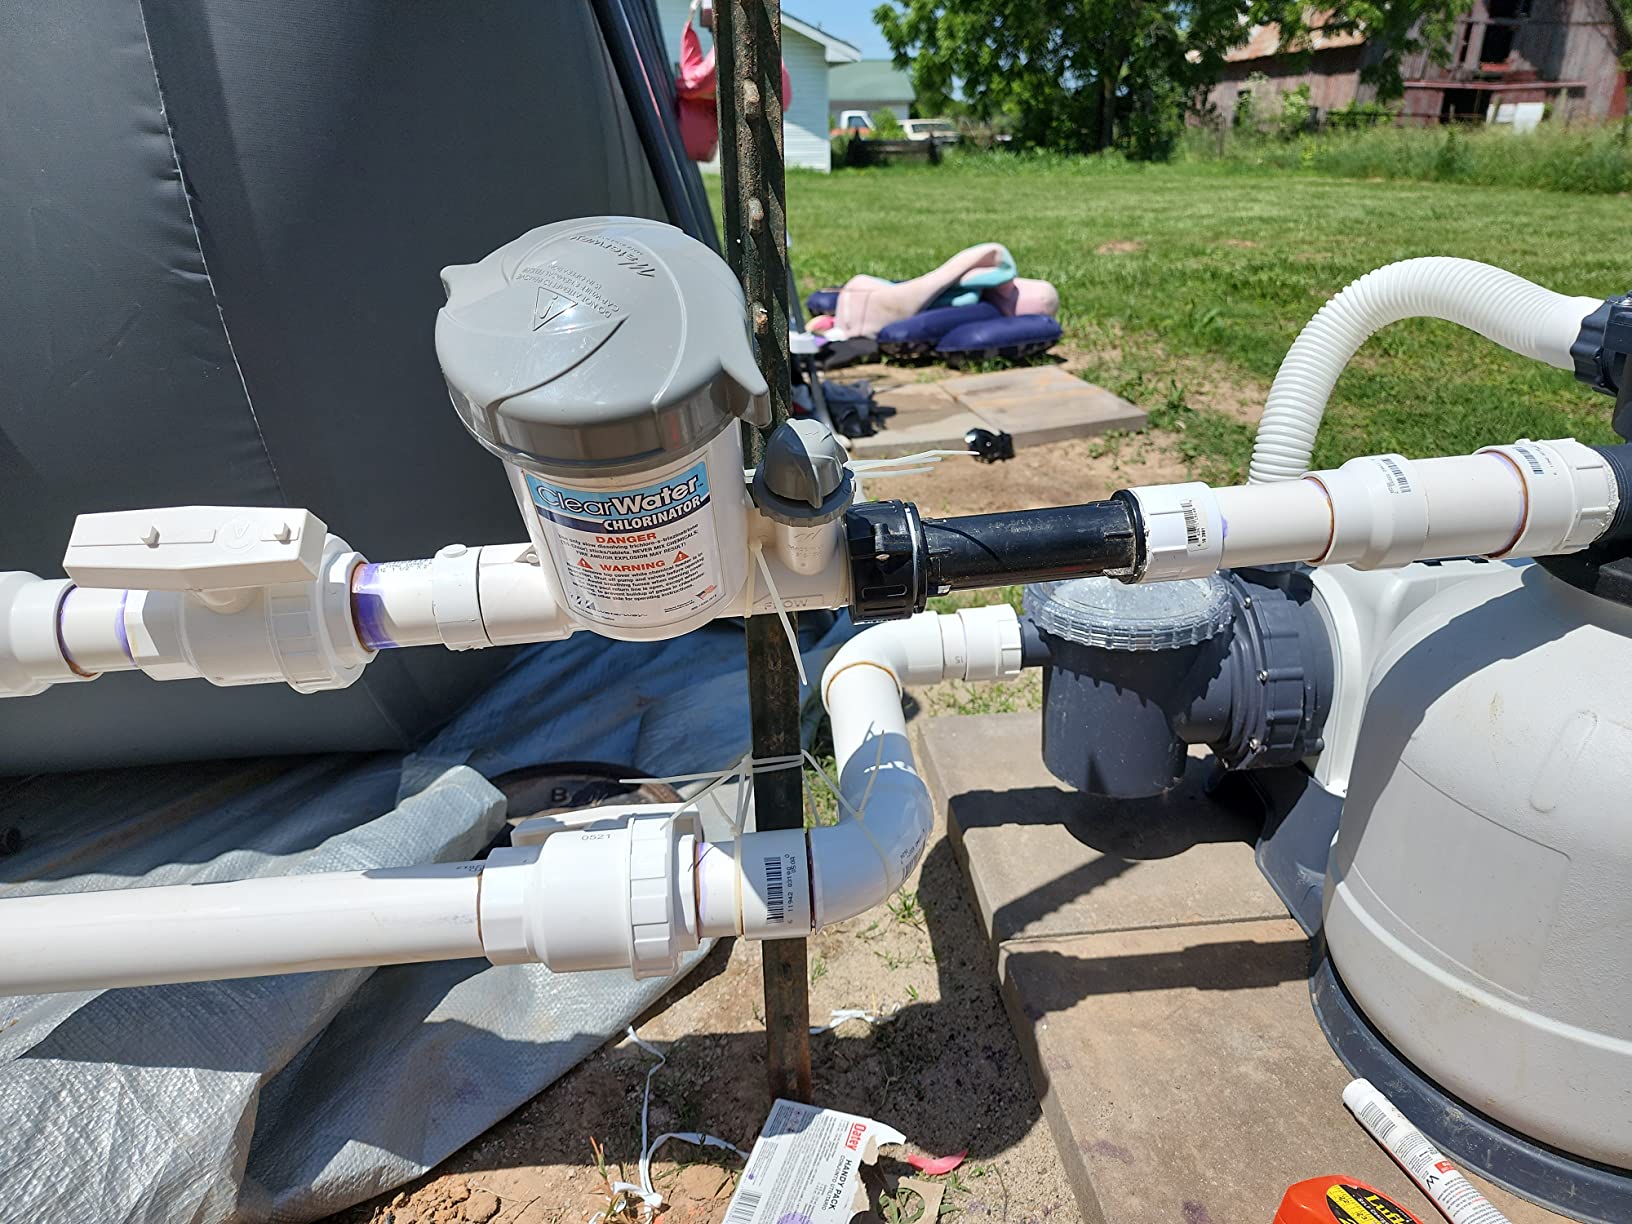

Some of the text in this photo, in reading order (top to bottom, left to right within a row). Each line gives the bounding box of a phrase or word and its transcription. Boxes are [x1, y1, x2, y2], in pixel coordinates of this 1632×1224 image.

[536, 473, 698, 516] ClearWater
[603, 495, 702, 531] CHLORINATOR
[595, 532, 657, 544] DANGER
[614, 553, 648, 561] EXPLOSION
[649, 550, 662, 558] MAY
[632, 546, 653, 554] NEVER
[599, 560, 666, 572] WARNING
[648, 564, 674, 575] chemical
[551, 786, 569, 803] B
[581, 833, 611, 841] 0521
[828, 1159, 853, 1210] HANDY PACK
